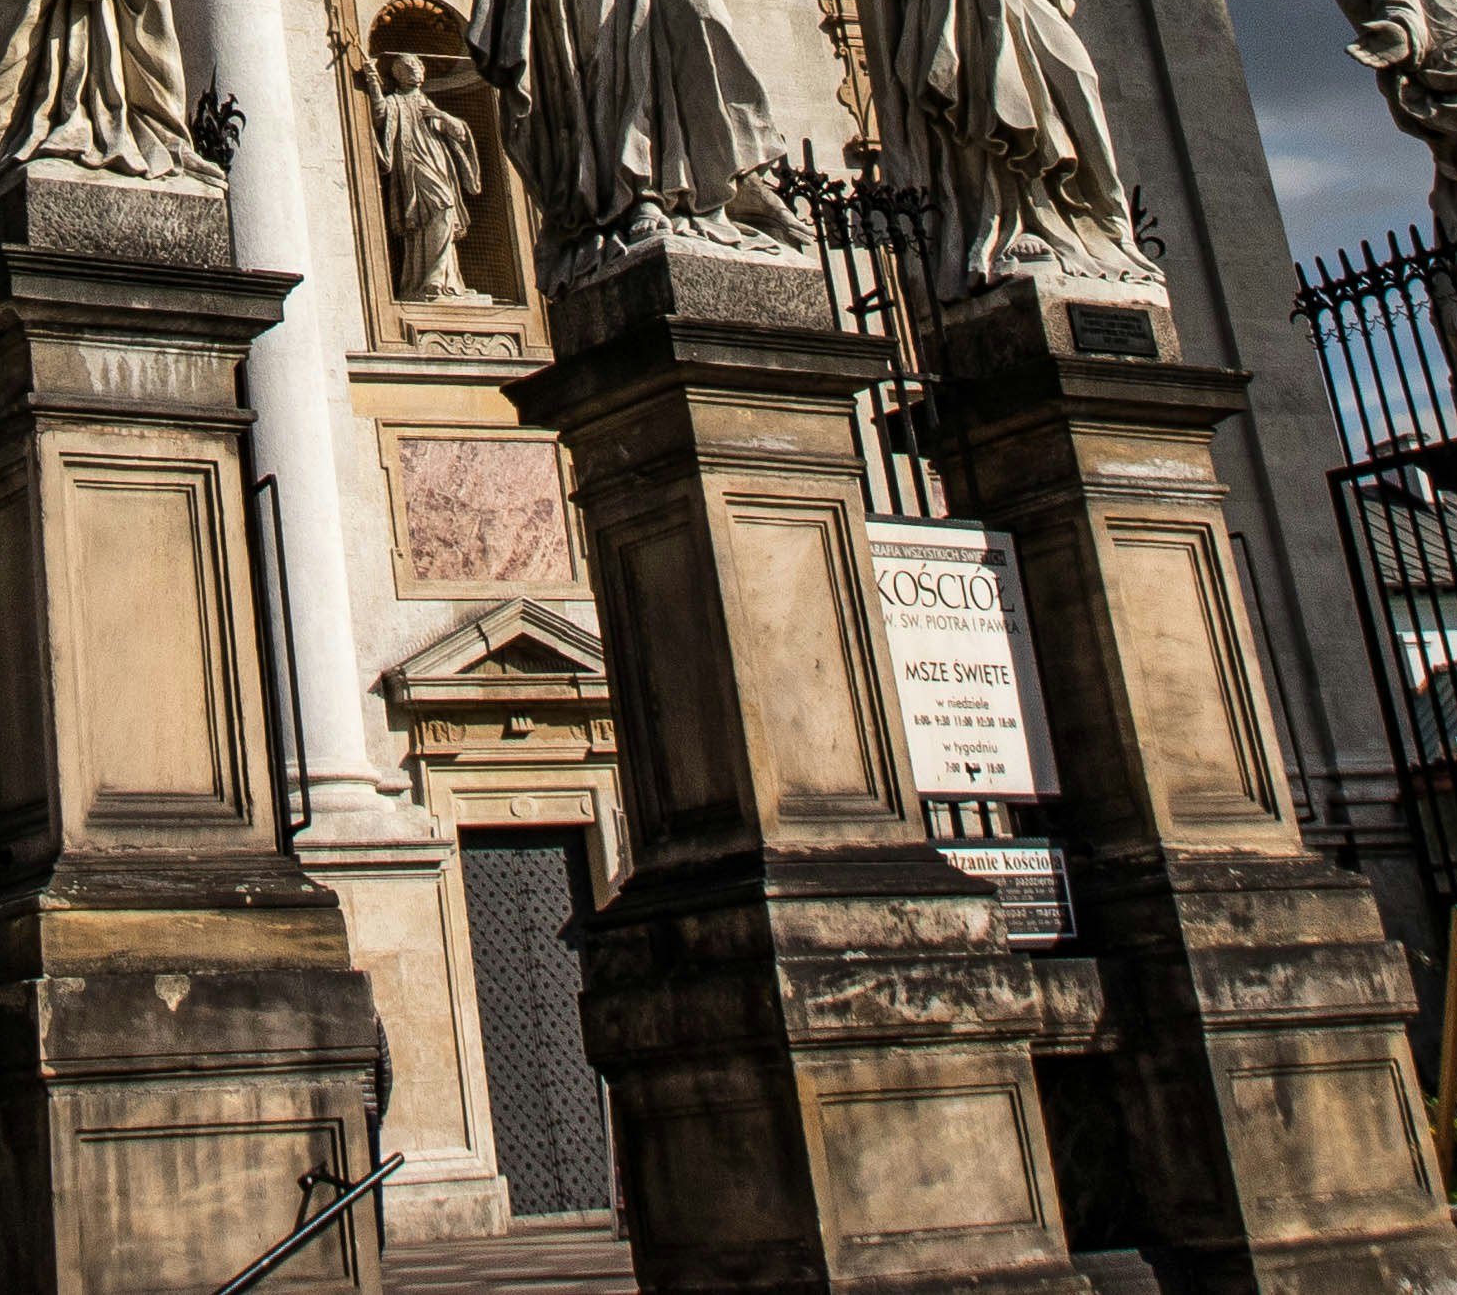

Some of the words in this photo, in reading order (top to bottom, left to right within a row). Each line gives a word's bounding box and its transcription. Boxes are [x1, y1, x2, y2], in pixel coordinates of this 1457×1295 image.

[871, 545, 901, 557] ARAFIA
[926, 615, 971, 631] PIOTRA
[905, 661, 949, 682] MSZE
[953, 659, 1011, 687] ŚWIĘTE
[947, 697, 989, 710] niedziele
[943, 743, 951, 751] w
[953, 740, 998, 756] tygodniu
[950, 851, 998, 870] dzanie
